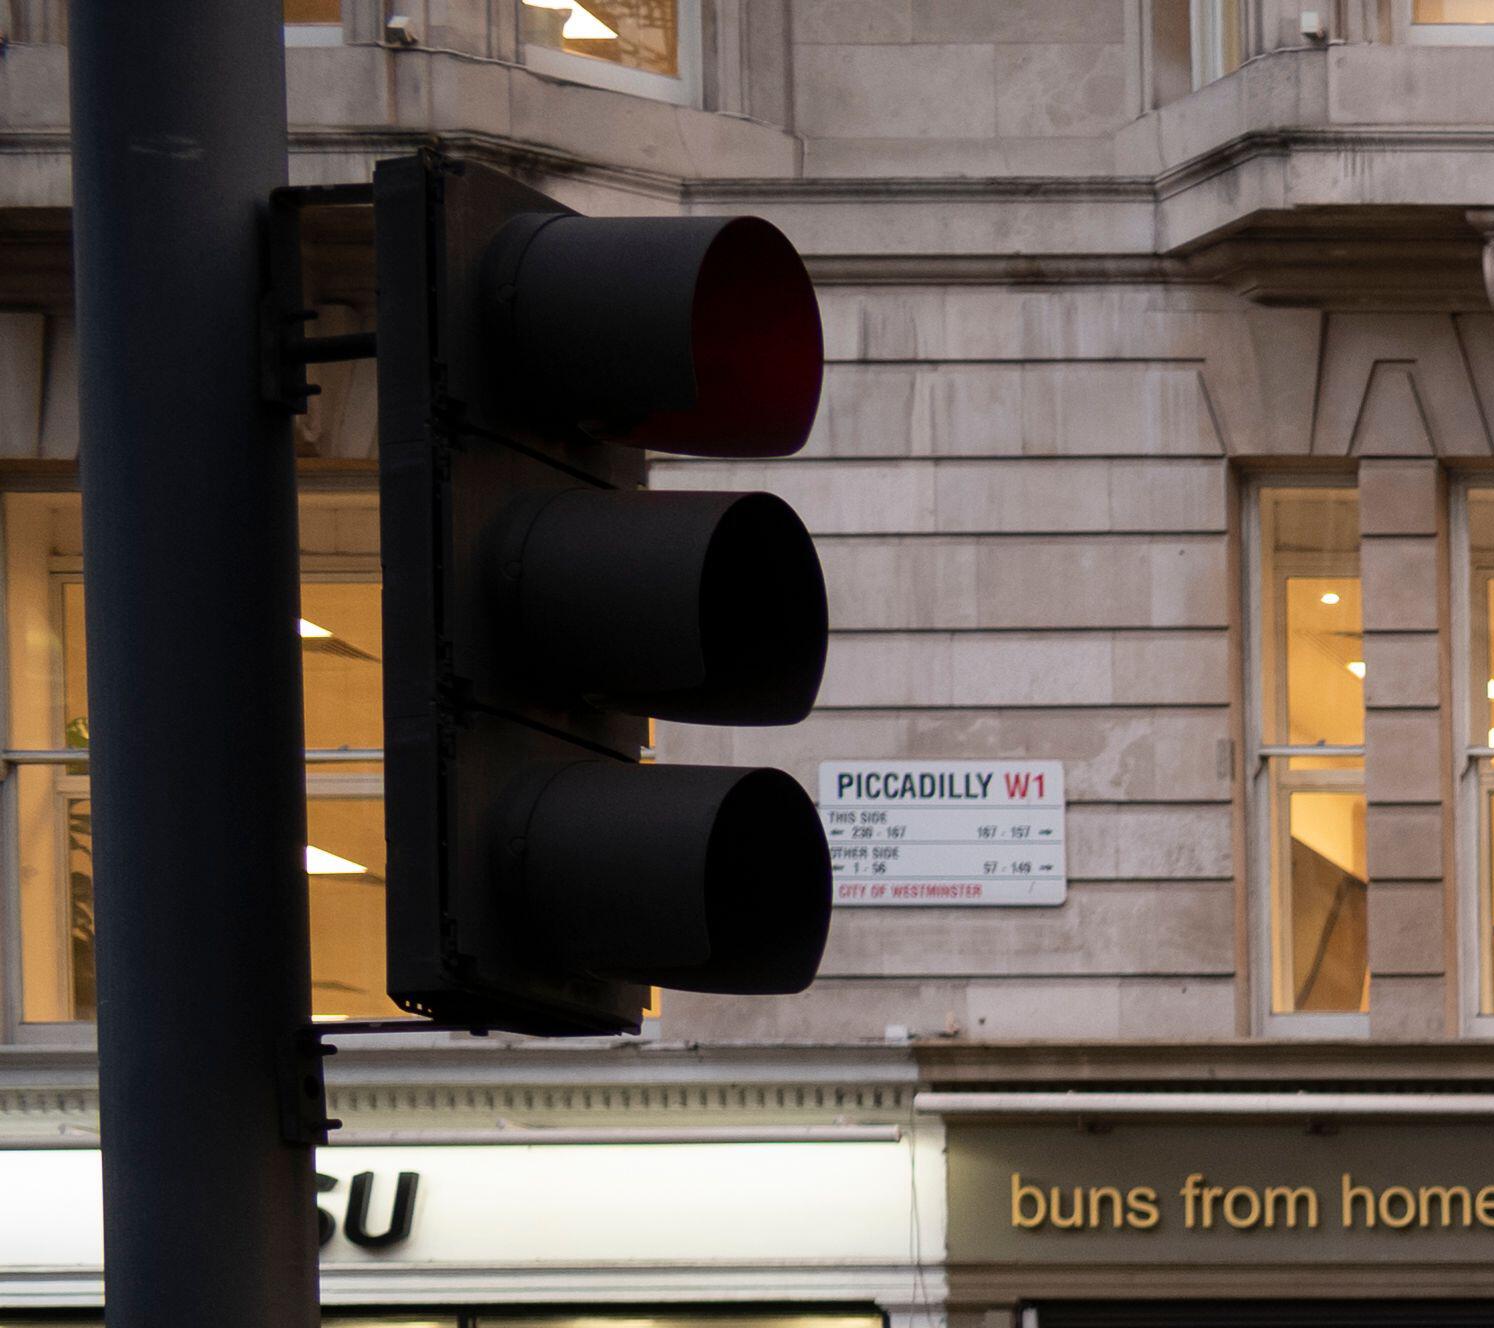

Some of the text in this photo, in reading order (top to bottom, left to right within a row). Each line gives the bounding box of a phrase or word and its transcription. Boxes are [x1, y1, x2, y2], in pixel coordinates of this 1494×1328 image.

[838, 772, 1045, 799] PICCADILLY W1
[829, 811, 888, 824] THIS SIDE
[872, 848, 900, 860] SIDE
[838, 884, 866, 898] CITY
[892, 884, 983, 898] WESTMINSTER
[1010, 1172, 1150, 1229] buns
[1180, 1172, 1318, 1229] from
